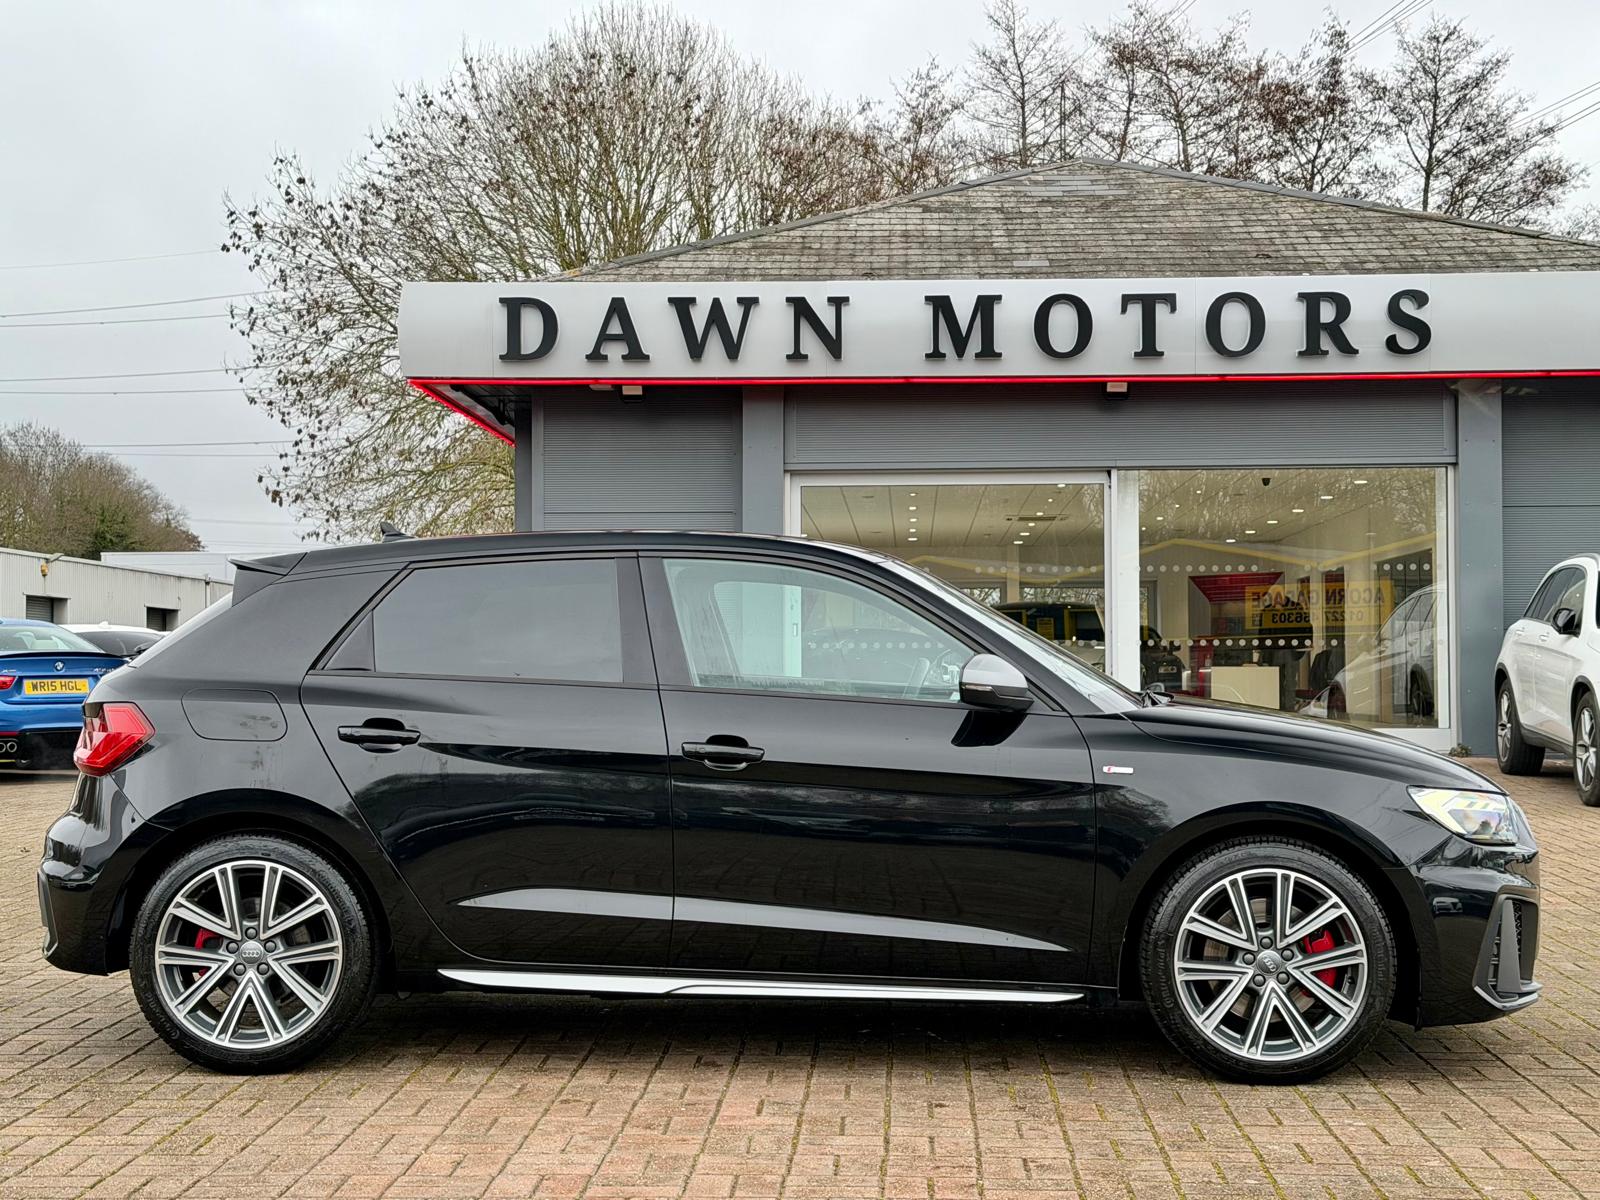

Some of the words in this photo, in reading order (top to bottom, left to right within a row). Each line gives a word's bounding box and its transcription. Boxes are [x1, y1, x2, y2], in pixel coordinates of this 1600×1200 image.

[499, 296, 851, 362] DAWN
[924, 289, 1432, 360] MOTORS
[31, 681, 57, 692] WR15
[60, 680, 82, 691] HGL
